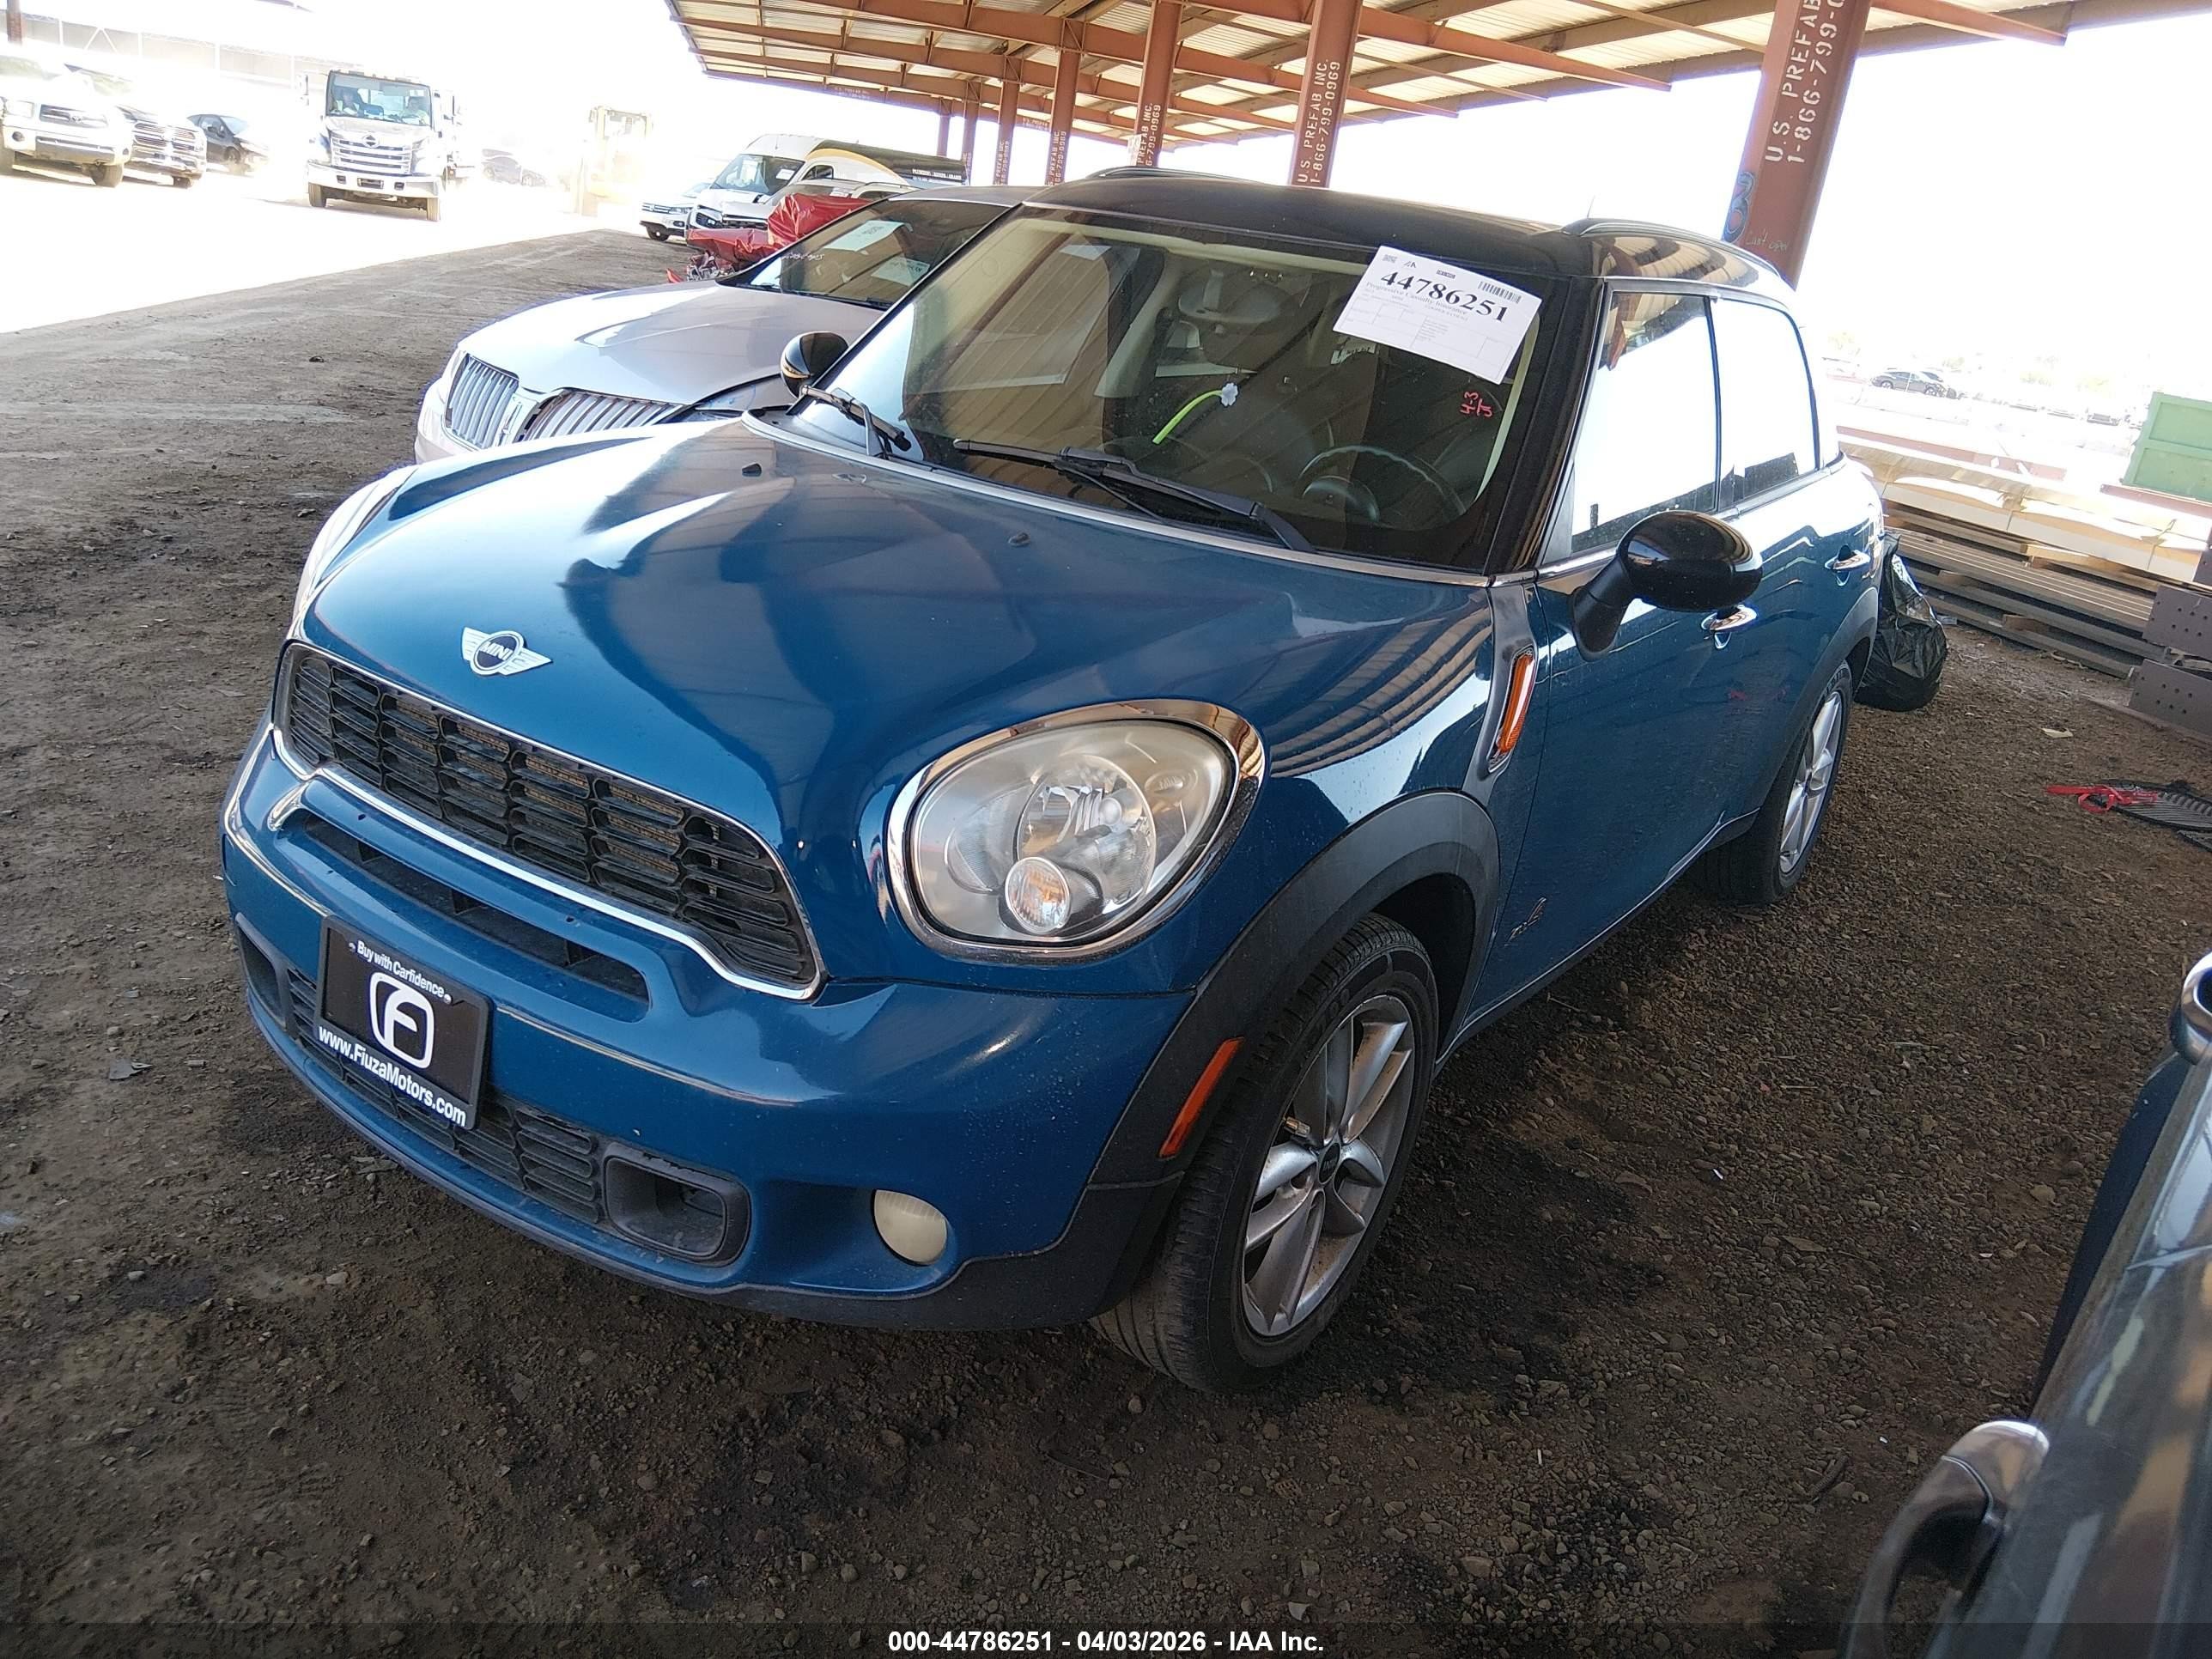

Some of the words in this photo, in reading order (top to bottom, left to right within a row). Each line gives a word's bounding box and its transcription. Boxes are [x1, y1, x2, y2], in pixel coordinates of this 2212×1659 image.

[1304, 93, 1322, 149] PREFAB
[1314, 58, 1329, 86] INC.
[1310, 61, 1341, 184] 1-866-799-0969
[1765, 114, 1794, 162] U.S.
[1781, 0, 1821, 99] PREFAB
[1380, 270, 1510, 324] 44786251
[481, 641, 514, 661] MINI
[356, 939, 374, 963] Buy
[373, 953, 393, 972] with
[392, 961, 446, 1000] Carfidence
[319, 1025, 467, 1127] www.FiuzaMotors.com
